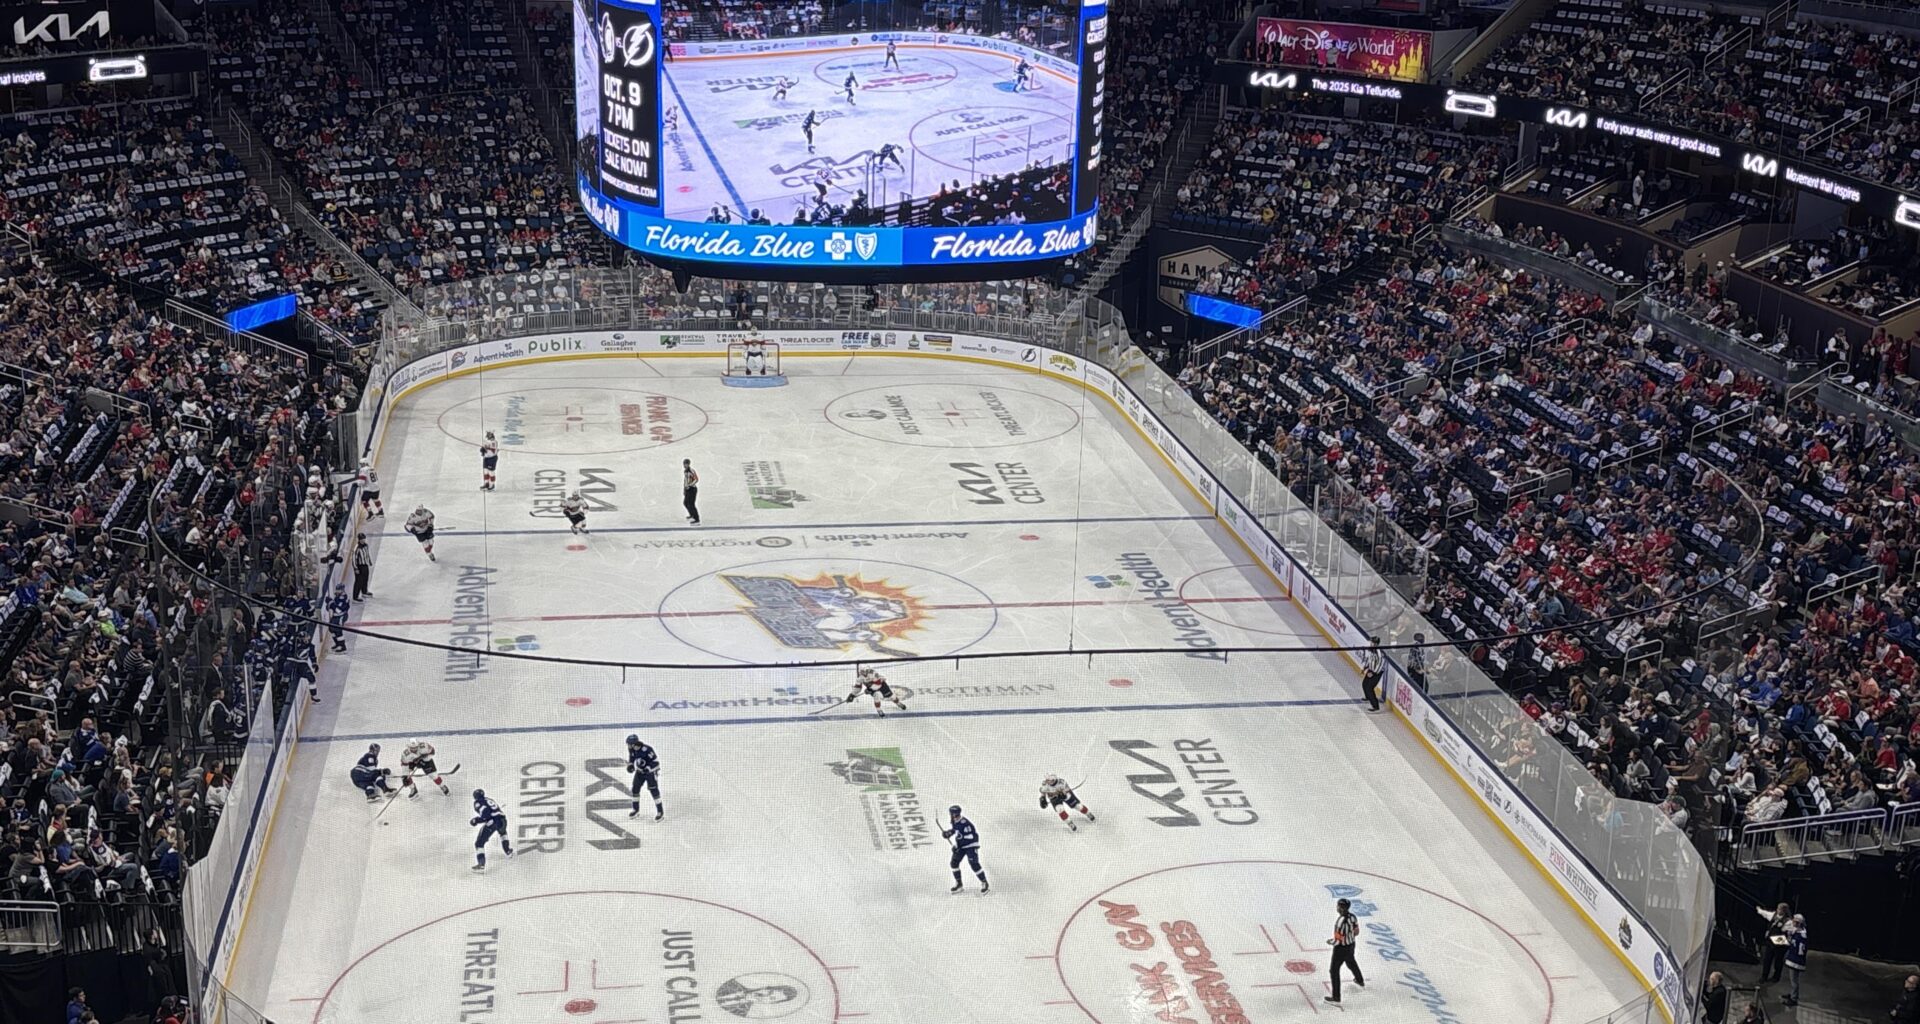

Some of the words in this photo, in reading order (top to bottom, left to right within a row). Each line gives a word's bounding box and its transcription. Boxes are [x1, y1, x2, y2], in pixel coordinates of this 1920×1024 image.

[14, 11, 110, 44] KIA
[1264, 24, 1298, 47] Walt
[1297, 26, 1358, 60] Disney
[1358, 37, 1395, 57] World
[13, 71, 46, 85] inspires
[604, 73, 626, 103] OCT.
[628, 81, 642, 107] 9
[1250, 71, 1298, 88] KIA
[1311, 79, 1328, 90] The
[1328, 81, 1350, 92] 2025
[1350, 83, 1364, 95] Kia
[1365, 85, 1402, 99] Telluride.
[607, 101, 613, 124] 7
[614, 107, 635, 132] PM
[1545, 107, 1588, 129] KIA
[603, 127, 630, 152] TICKETS
[631, 138, 650, 159] ON
[1596, 117, 1603, 129] If
[1603, 121, 1619, 135] only
[1619, 124, 1635, 137] your
[1635, 127, 1653, 142] seats
[1654, 132, 1671, 144] were
[1671, 135, 1680, 146] as
[1680, 137, 1699, 151] good
[1698, 142, 1706, 153] as
[604, 148, 620, 170] SALE
[620, 156, 648, 178] NOW!
[1742, 152, 1778, 178] KIA
[1785, 168, 1820, 188] Movement
[1820, 178, 1833, 194] that
[1833, 182, 1861, 203] inspires
[645, 224, 746, 257] Florida
[750, 232, 815, 259] Blue
[930, 234, 1035, 260] Florida
[1037, 229, 1081, 256] Blue
[528, 337, 584, 354] Publix
[600, 340, 637, 348] Gallagher
[841, 332, 870, 340] FREE
[473, 349, 524, 363] AdventHealth
[579, 468, 618, 512] KIA
[949, 462, 1006, 505] KIA
[994, 461, 1046, 505] CENTER
[815, 532, 969, 542] AdventHealth
[443, 565, 498, 682] AdventHealth
[1115, 552, 1226, 661] AdventHealth
[650, 694, 842, 711] AdventHealth
[917, 683, 1055, 696] ROTHMAN
[1108, 739, 1202, 828] KIA
[1173, 738, 1260, 826] CENTER
[517, 760, 567, 856] CENTER
[585, 758, 642, 852] KIA
[896, 792, 934, 849] RENEWAL
[879, 799, 909, 851] ANDERSEN
[1549, 846, 1566, 873] PINK
[1565, 862, 1599, 906] WHITNEY
[660, 928, 697, 973] JUST
[1365, 921, 1417, 966] Blue
[459, 927, 499, 1024] THREATL
[665, 976, 702, 1024] CALL
